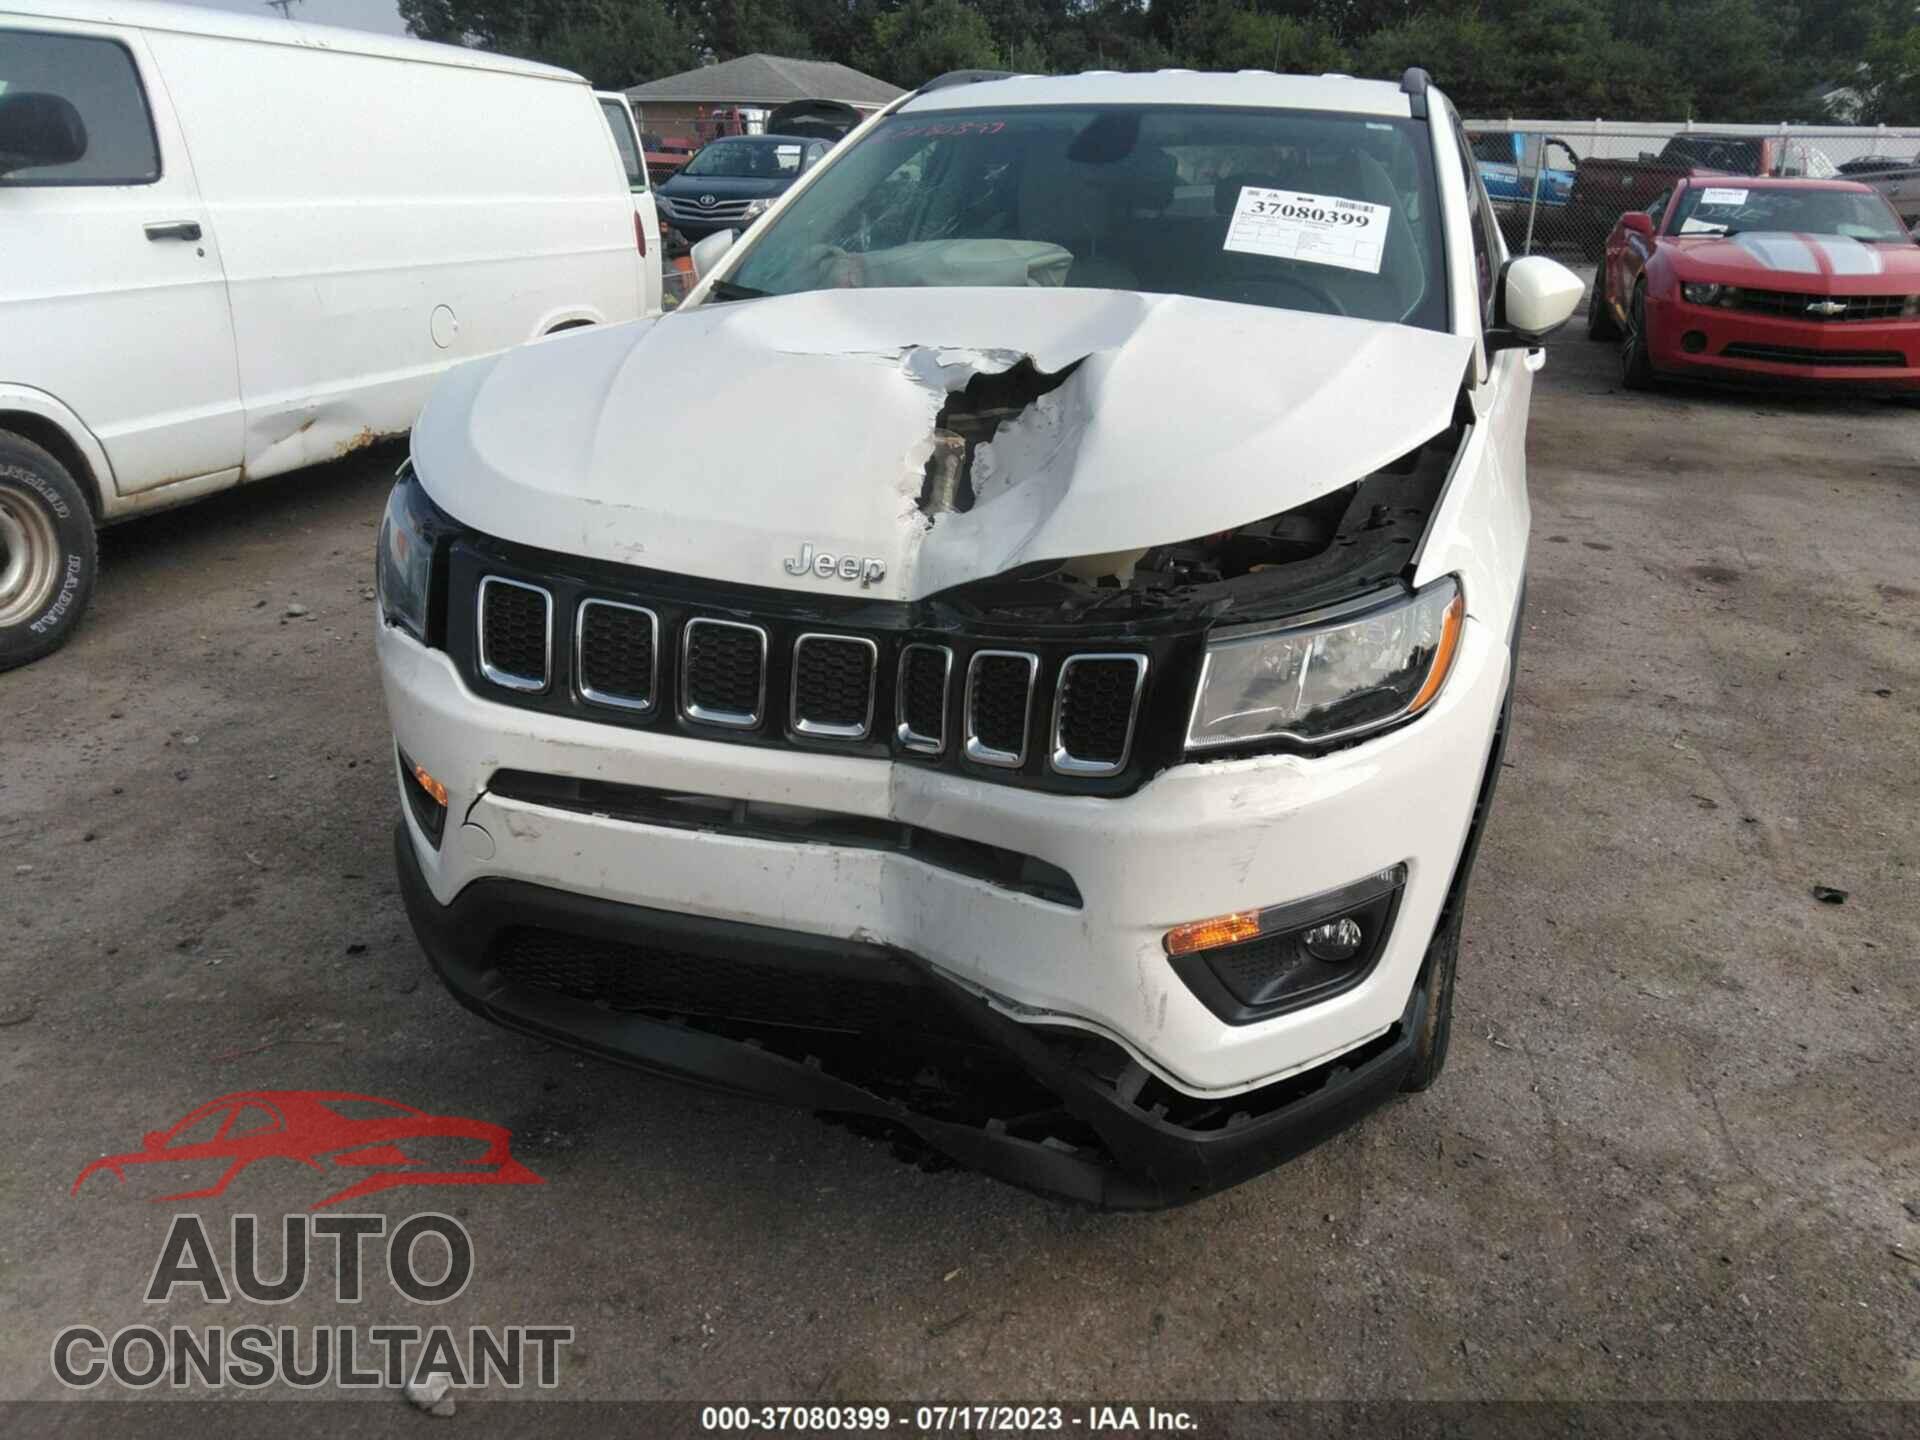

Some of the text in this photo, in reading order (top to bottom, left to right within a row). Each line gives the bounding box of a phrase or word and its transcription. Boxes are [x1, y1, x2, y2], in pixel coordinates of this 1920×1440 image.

[1250, 200, 1370, 228] 37080399
[784, 542, 887, 589] Jeep
[30, 554, 81, 634] RADIAL
